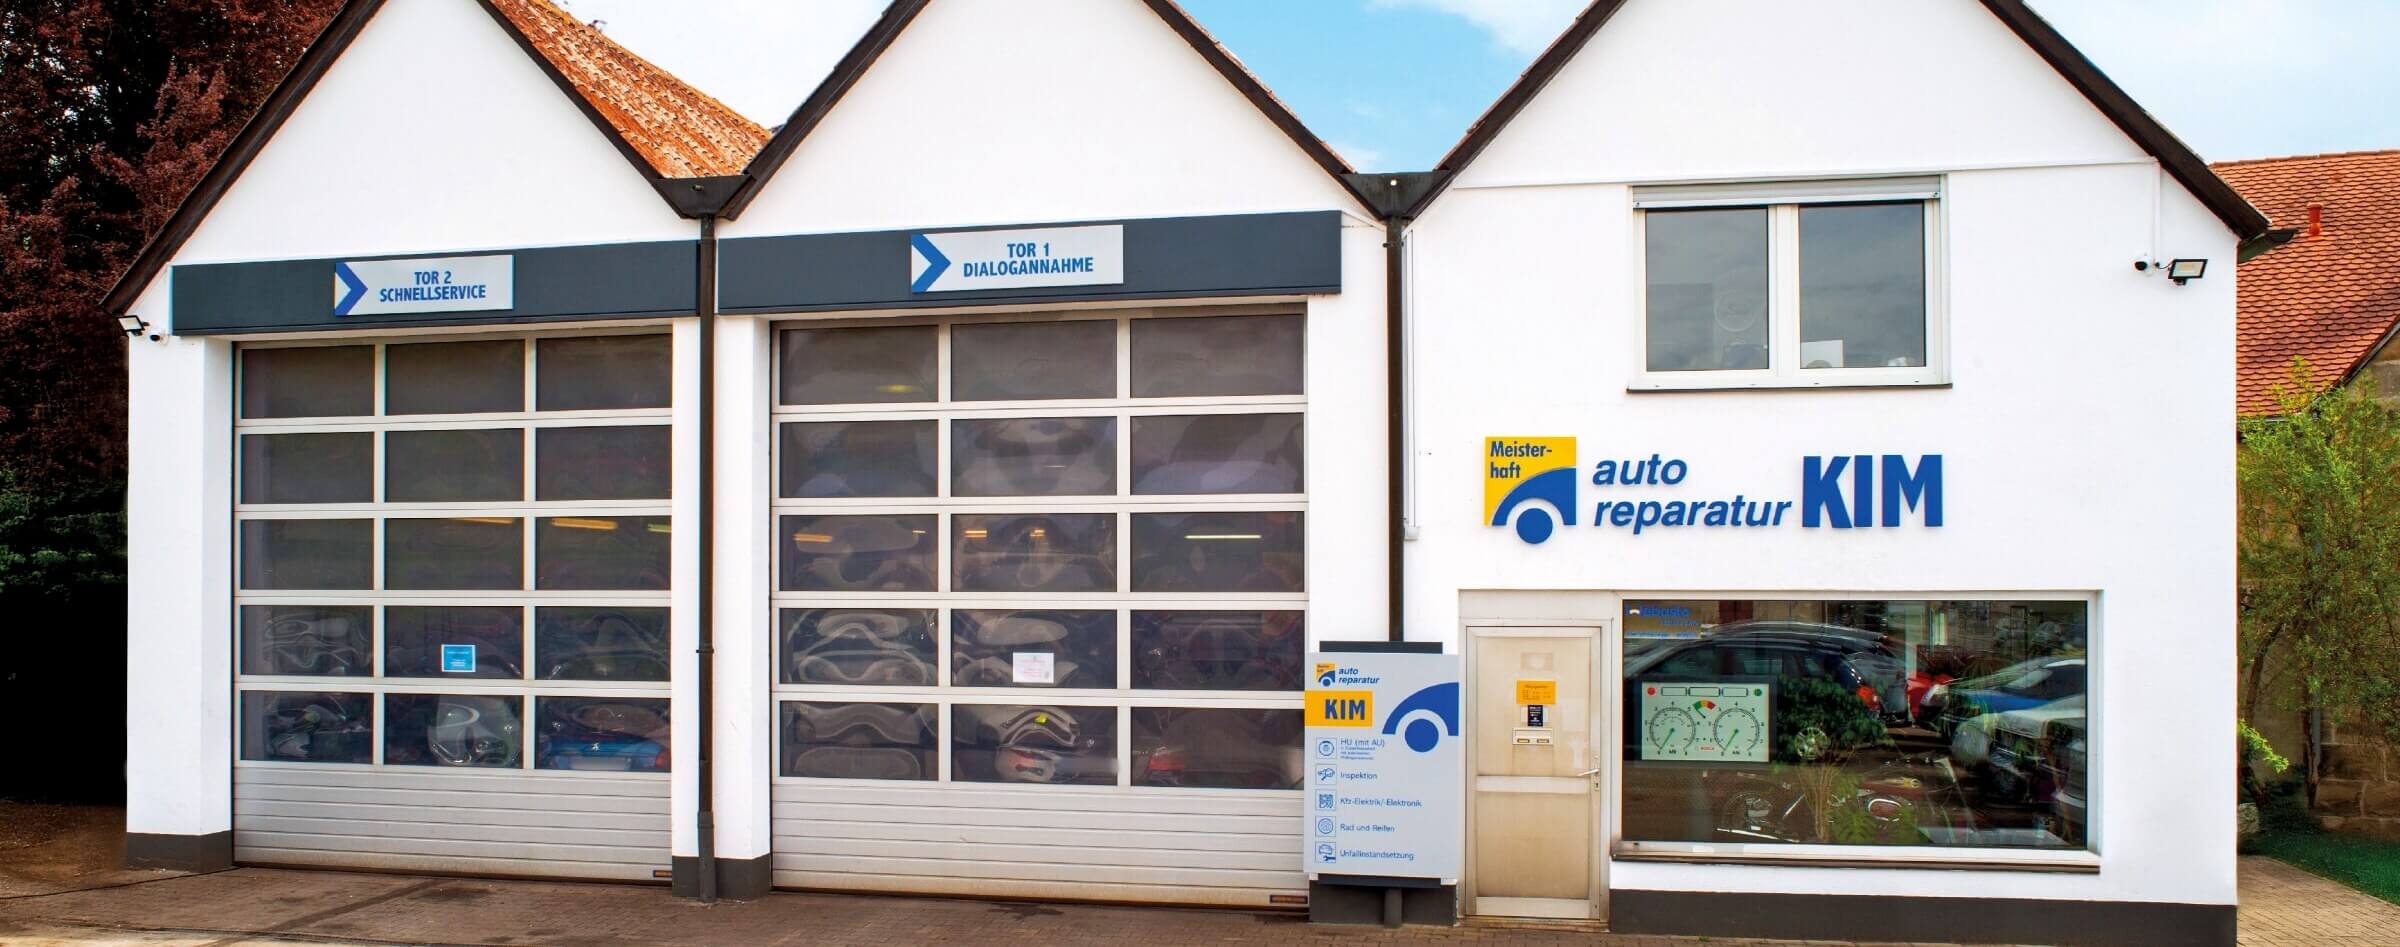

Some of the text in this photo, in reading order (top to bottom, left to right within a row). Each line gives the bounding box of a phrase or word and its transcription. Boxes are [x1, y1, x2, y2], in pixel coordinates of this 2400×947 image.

[1007, 242, 1050, 257] TOR 1
[963, 257, 1093, 277] DIALOGANNAHME
[414, 270, 452, 285] TOR 2
[380, 285, 486, 302] SCHNELLSERVICE
[1490, 440, 1553, 458] Meister-
[1490, 461, 1521, 479] haft
[1593, 454, 1687, 485] auto
[1801, 454, 1944, 529] KIM
[1594, 495, 1792, 534] reparatur
[1338, 667, 1359, 675] auto
[1325, 699, 1366, 720] KIM
[1340, 771, 1378, 780] Inspektion
[1372, 825, 1395, 833] Reifen
[1340, 850, 1414, 861] Unfallinstandsetzung
